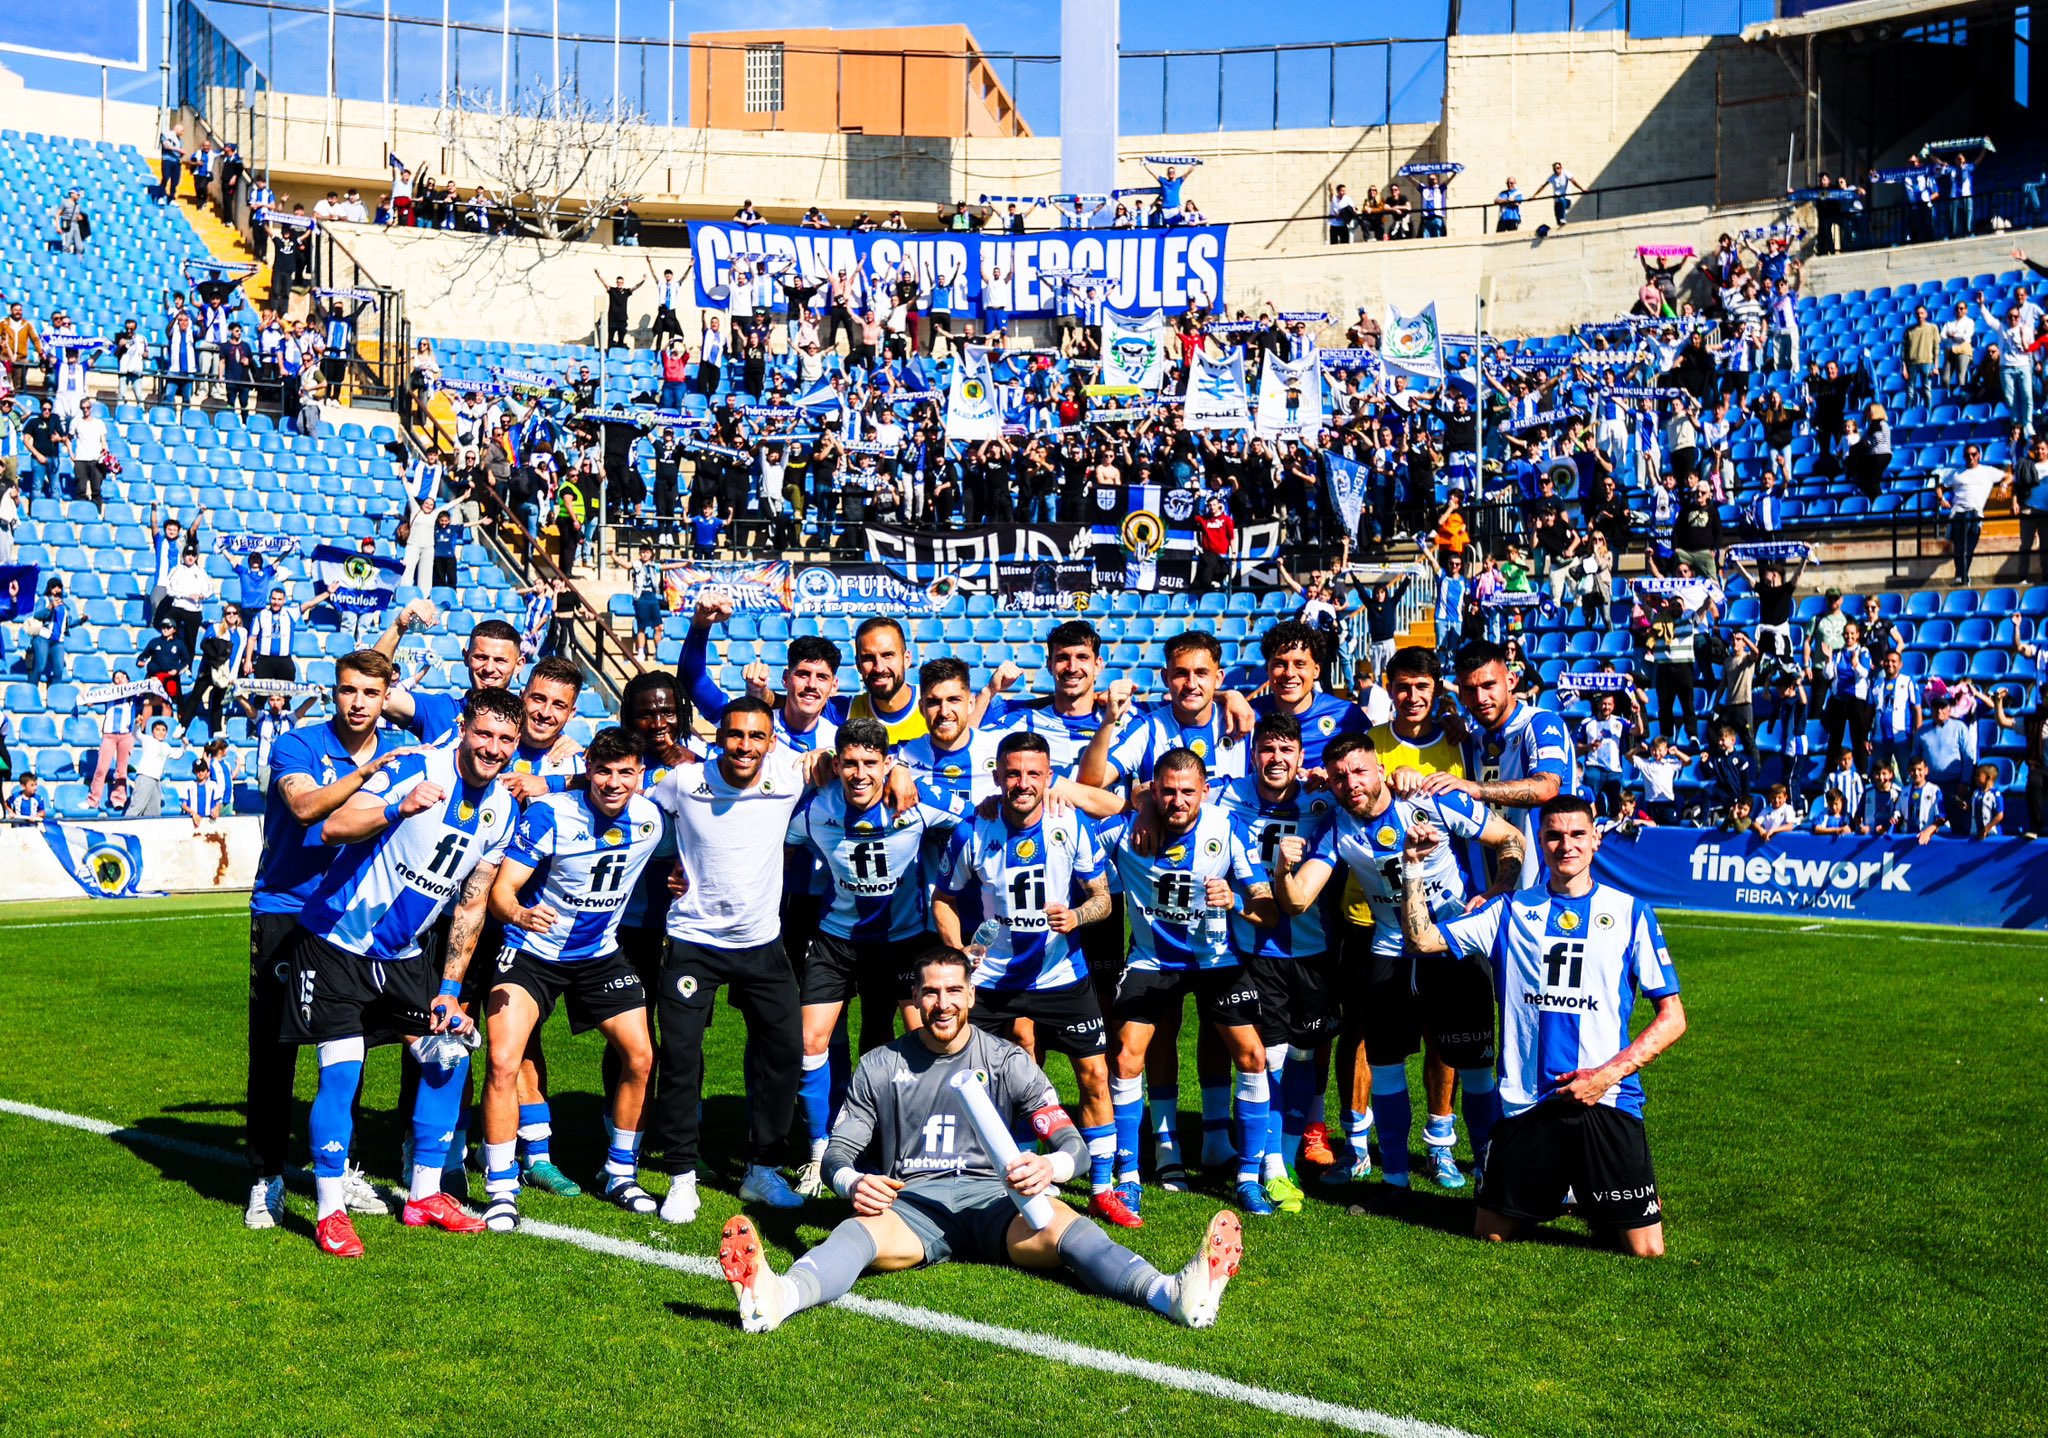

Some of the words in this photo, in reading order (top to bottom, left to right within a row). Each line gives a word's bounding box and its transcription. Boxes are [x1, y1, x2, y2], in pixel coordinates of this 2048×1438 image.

[870, 239, 967, 311] SUR
[981, 233, 1219, 312] HERCULES
[746, 406, 798, 418] hérculescf
[953, 408, 995, 419] ALICANTE
[1097, 570, 1125, 584] URVA
[1159, 576, 1185, 589] SUR
[427, 833, 469, 879] fi
[850, 842, 889, 879] fi
[590, 854, 628, 892] fi
[1690, 843, 1912, 893] finetwork
[395, 861, 458, 900] network
[838, 875, 905, 895] network
[1009, 869, 1047, 910] fi
[1154, 873, 1193, 908] fi
[562, 891, 629, 910] network
[1736, 888, 1783, 905] FIBRA
[1787, 891, 1799, 907] Y
[1803, 889, 1855, 909] MÓVIL
[995, 914, 1046, 928] netwo
[1136, 905, 1204, 922] network
[1543, 943, 1584, 988] fi
[1524, 991, 1598, 1012] network
[1438, 1030, 1492, 1044] VISSUM
[922, 1114, 956, 1153] fi
[904, 1156, 967, 1170] network
[1593, 1183, 1656, 1201] VISSUM
